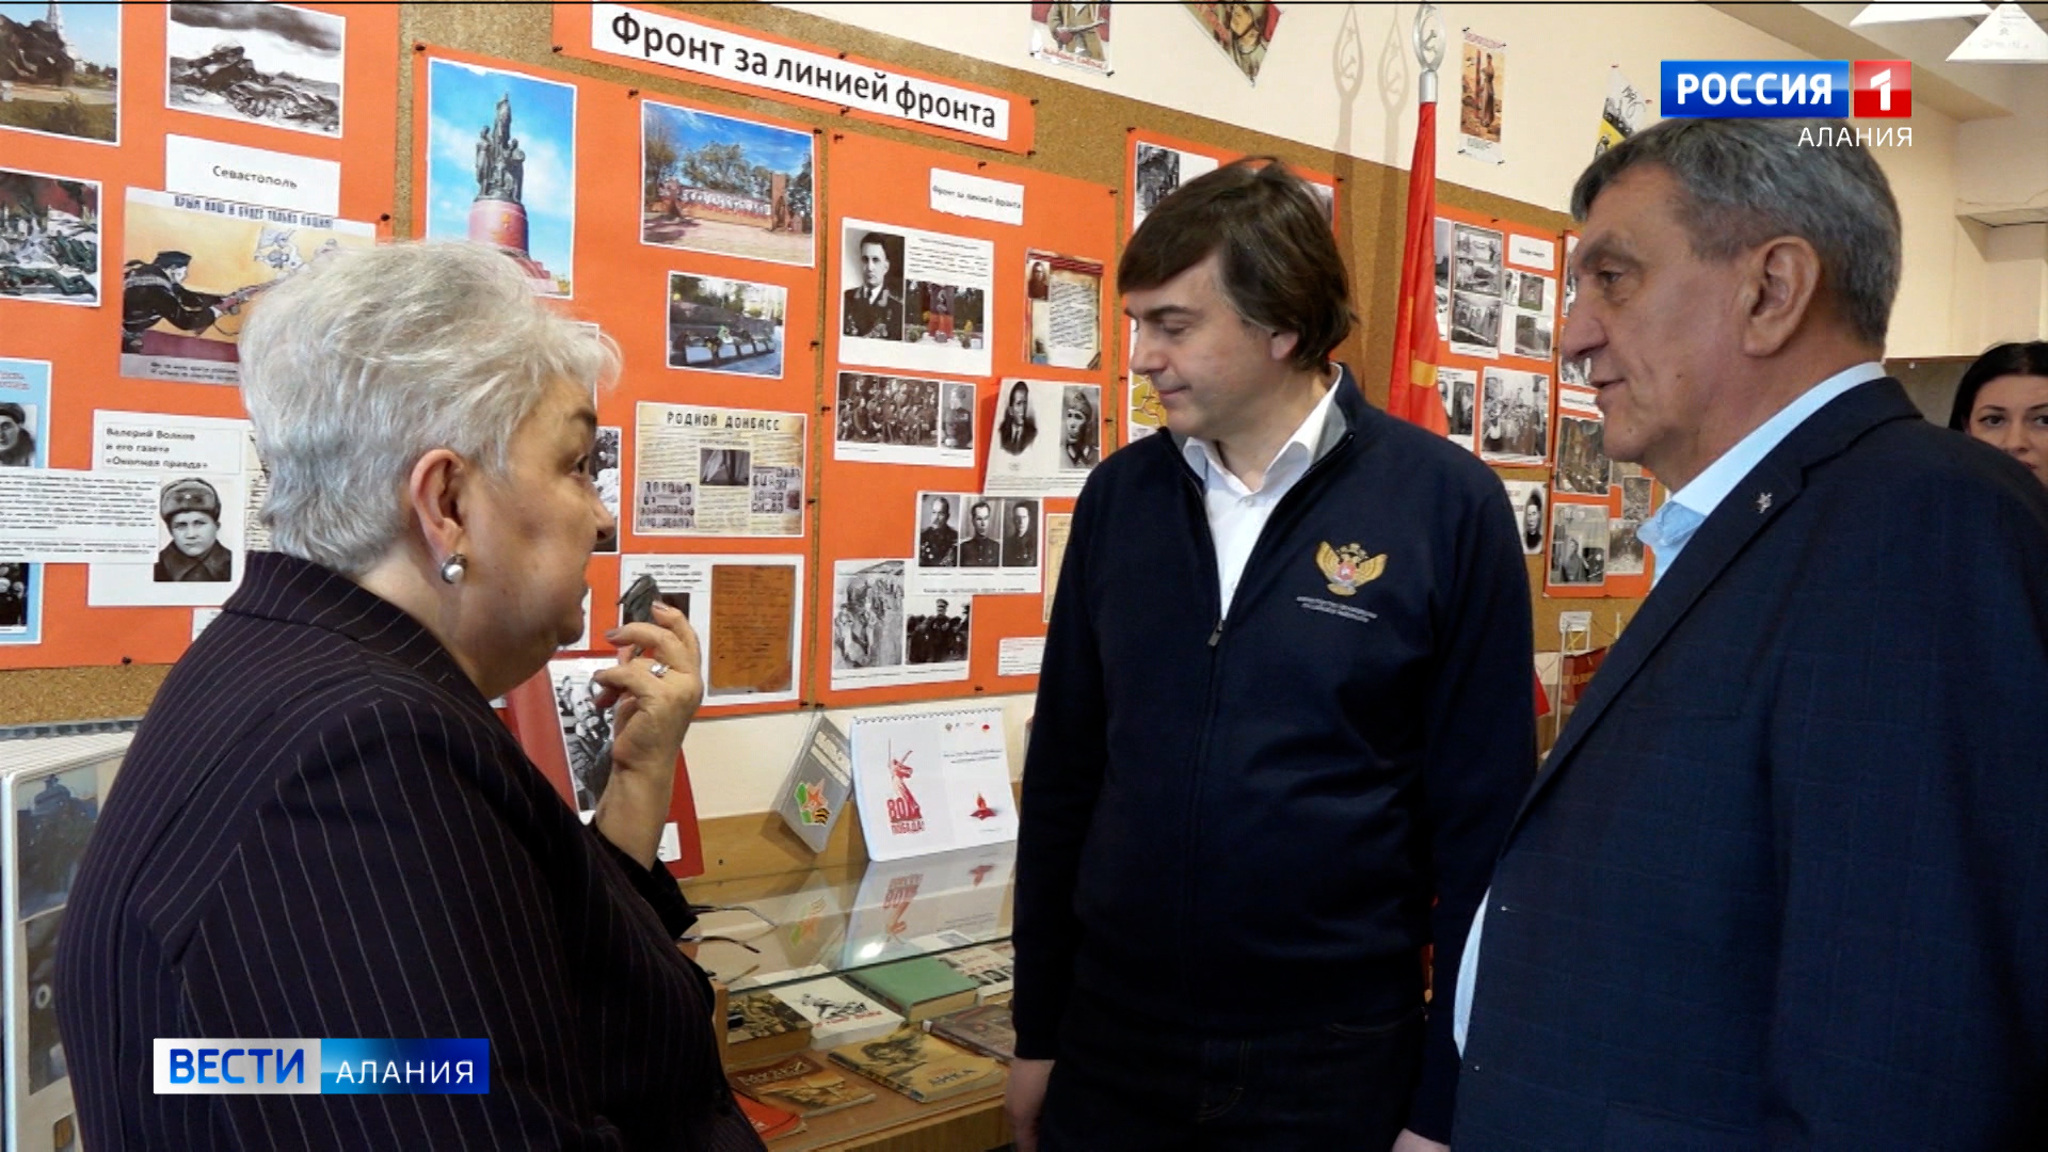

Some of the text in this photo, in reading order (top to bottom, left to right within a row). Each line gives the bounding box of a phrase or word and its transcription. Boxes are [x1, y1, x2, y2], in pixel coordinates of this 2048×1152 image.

[612, 12, 996, 128] Фронт за линией фронта
[213, 165, 297, 189] Севастополь
[667, 411, 780, 431] РОДНОЙ ДОНБАСС
